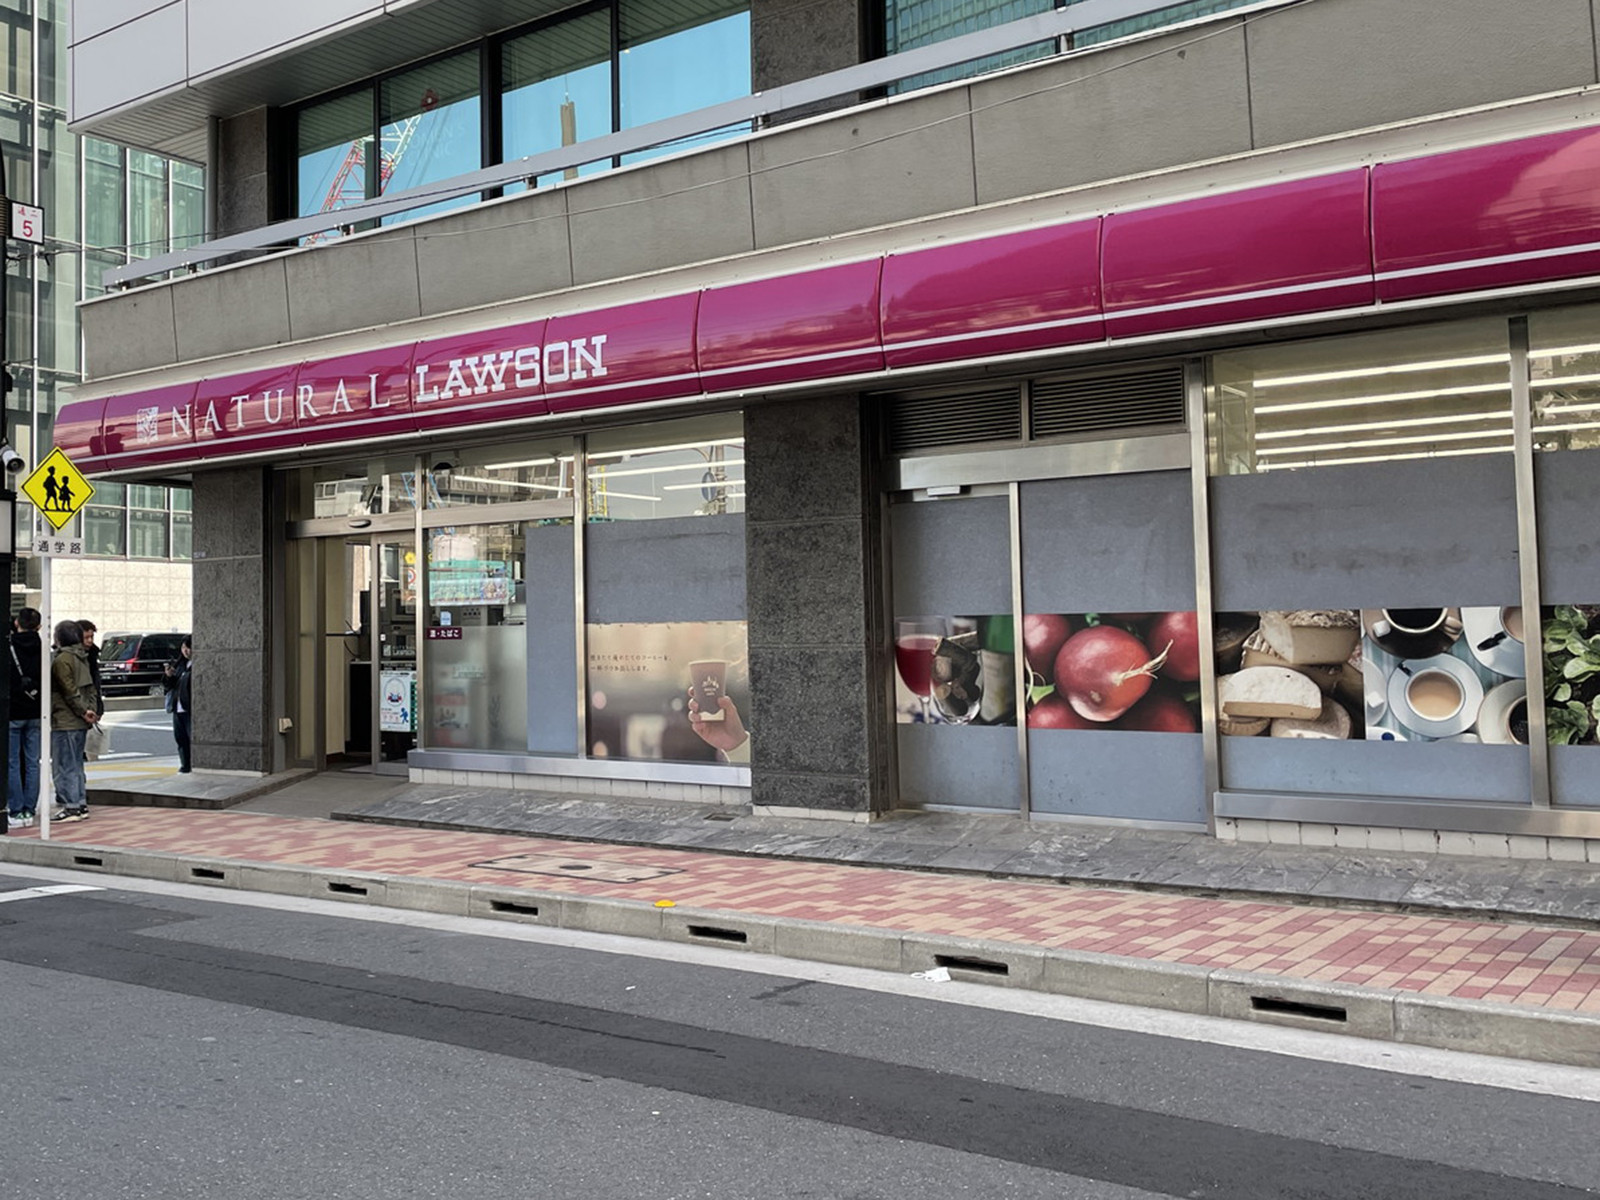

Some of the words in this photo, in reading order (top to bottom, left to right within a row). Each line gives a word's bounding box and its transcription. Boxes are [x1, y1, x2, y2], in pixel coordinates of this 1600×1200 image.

[23, 220, 33, 238] 5
[171, 373, 390, 438] NATURAL
[415, 334, 608, 403] LAWSON
[38, 540, 81, 554] 通学路
